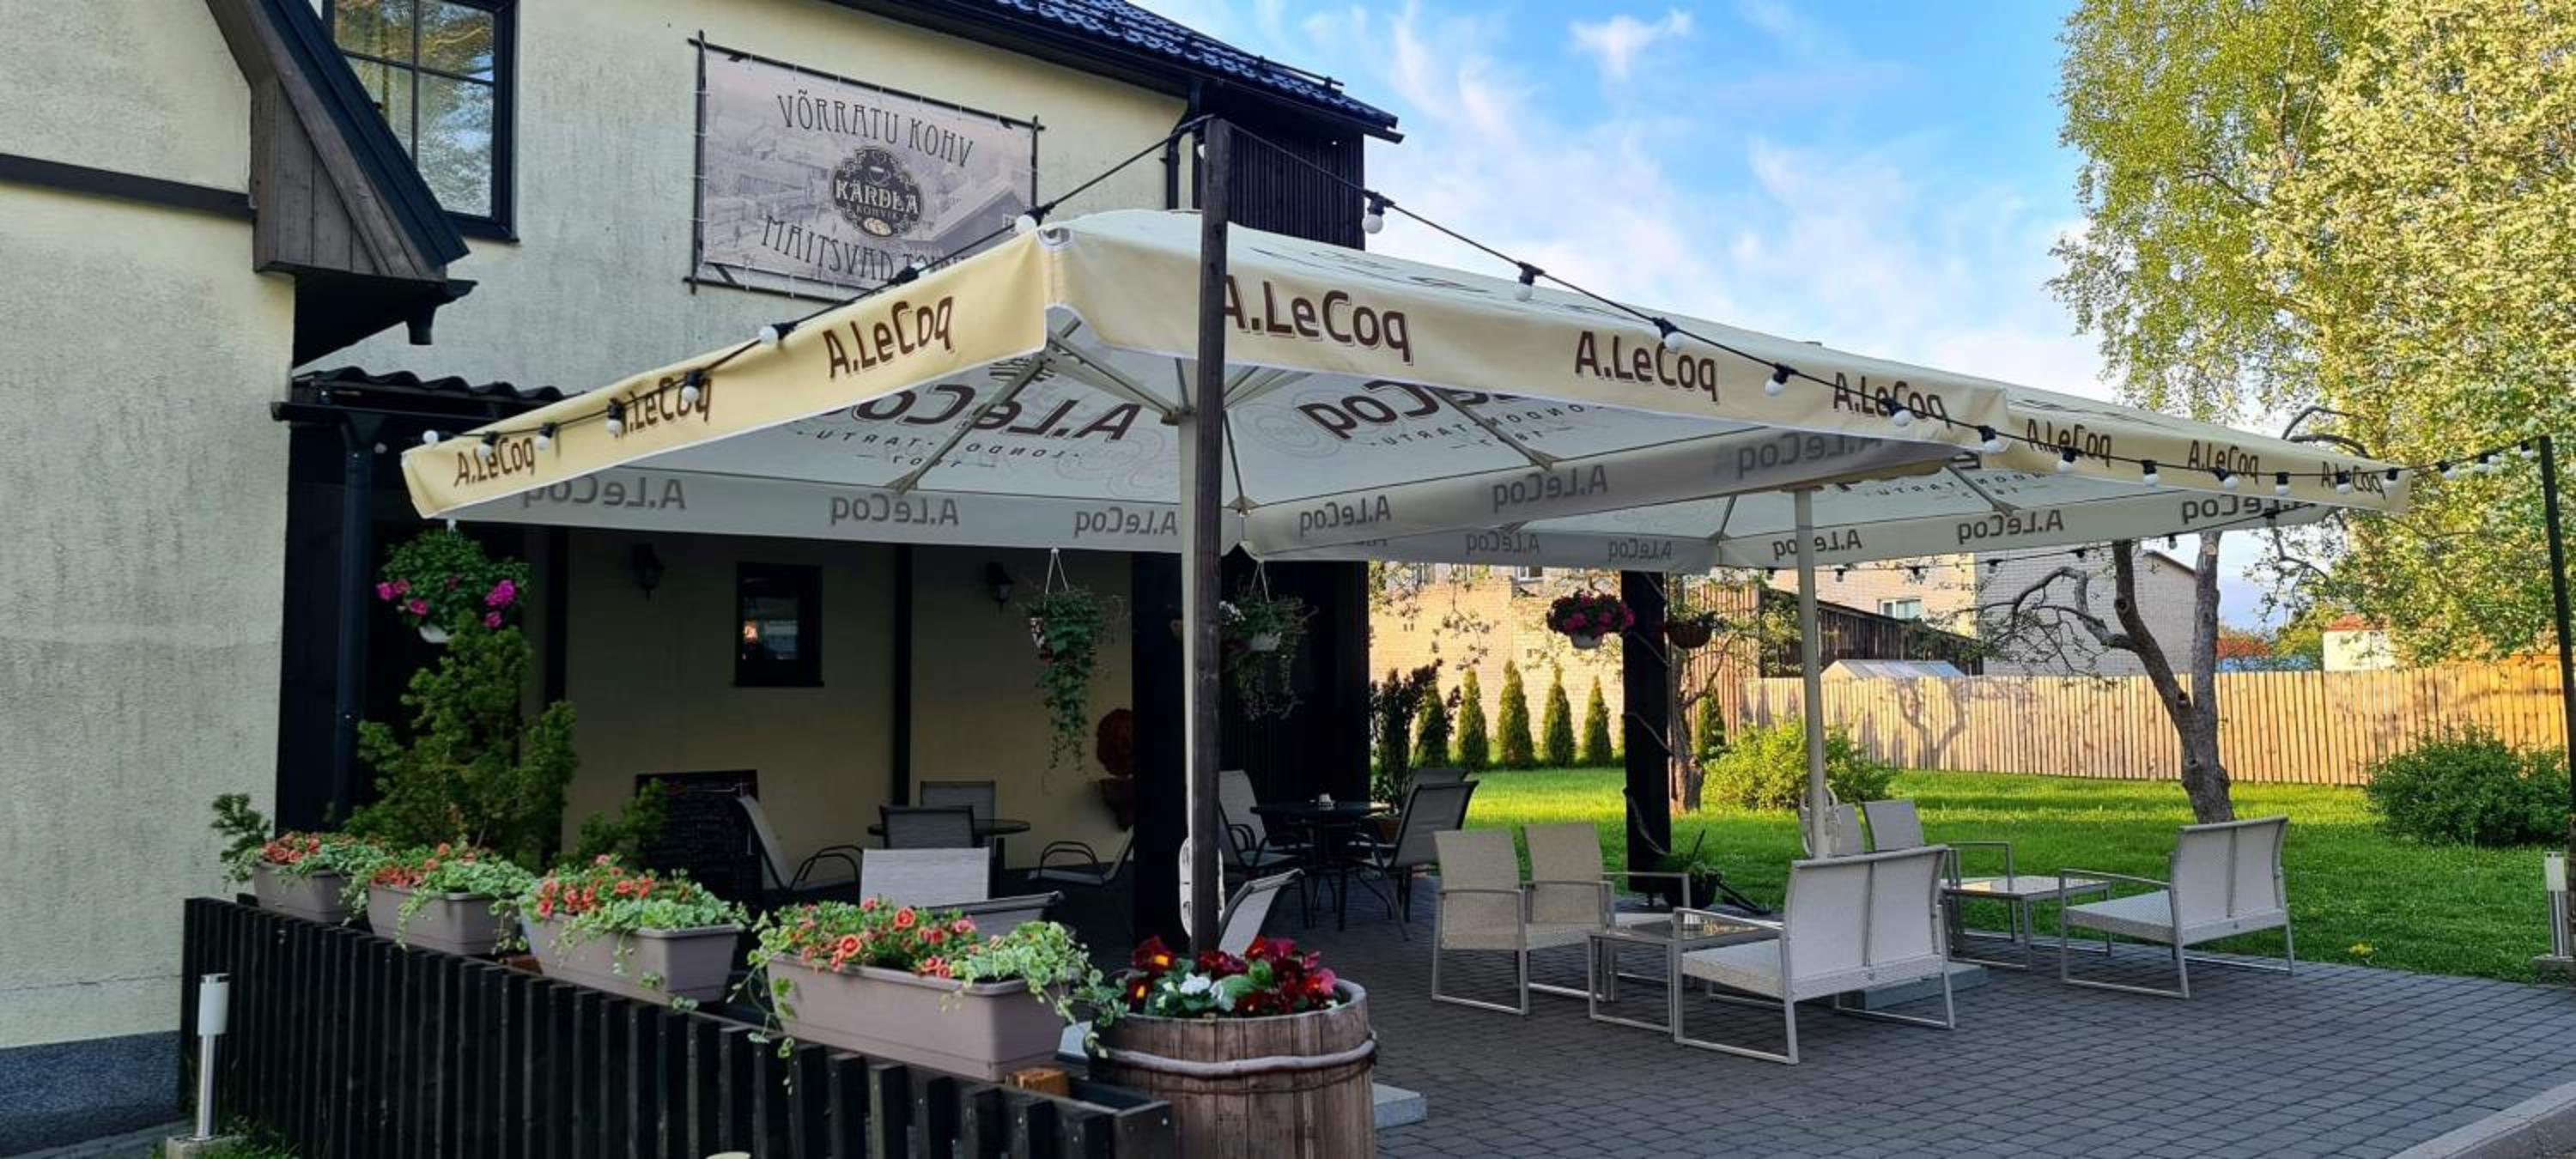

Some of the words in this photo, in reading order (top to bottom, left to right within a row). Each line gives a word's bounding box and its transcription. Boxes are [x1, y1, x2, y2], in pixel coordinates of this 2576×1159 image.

[777, 88, 899, 144] VÕRRATU
[908, 117, 974, 167] KOHV
[761, 215, 895, 282] MAITSVAD
[822, 295, 953, 379] A.LeCoq
[1224, 274, 1413, 367] A.LeCoq
[1574, 330, 1719, 404] A.LeCoq
[1832, 371, 1953, 430] A.LeCoq
[613, 377, 714, 440] .LeCoq
[453, 437, 535, 487] A.LeCoq
